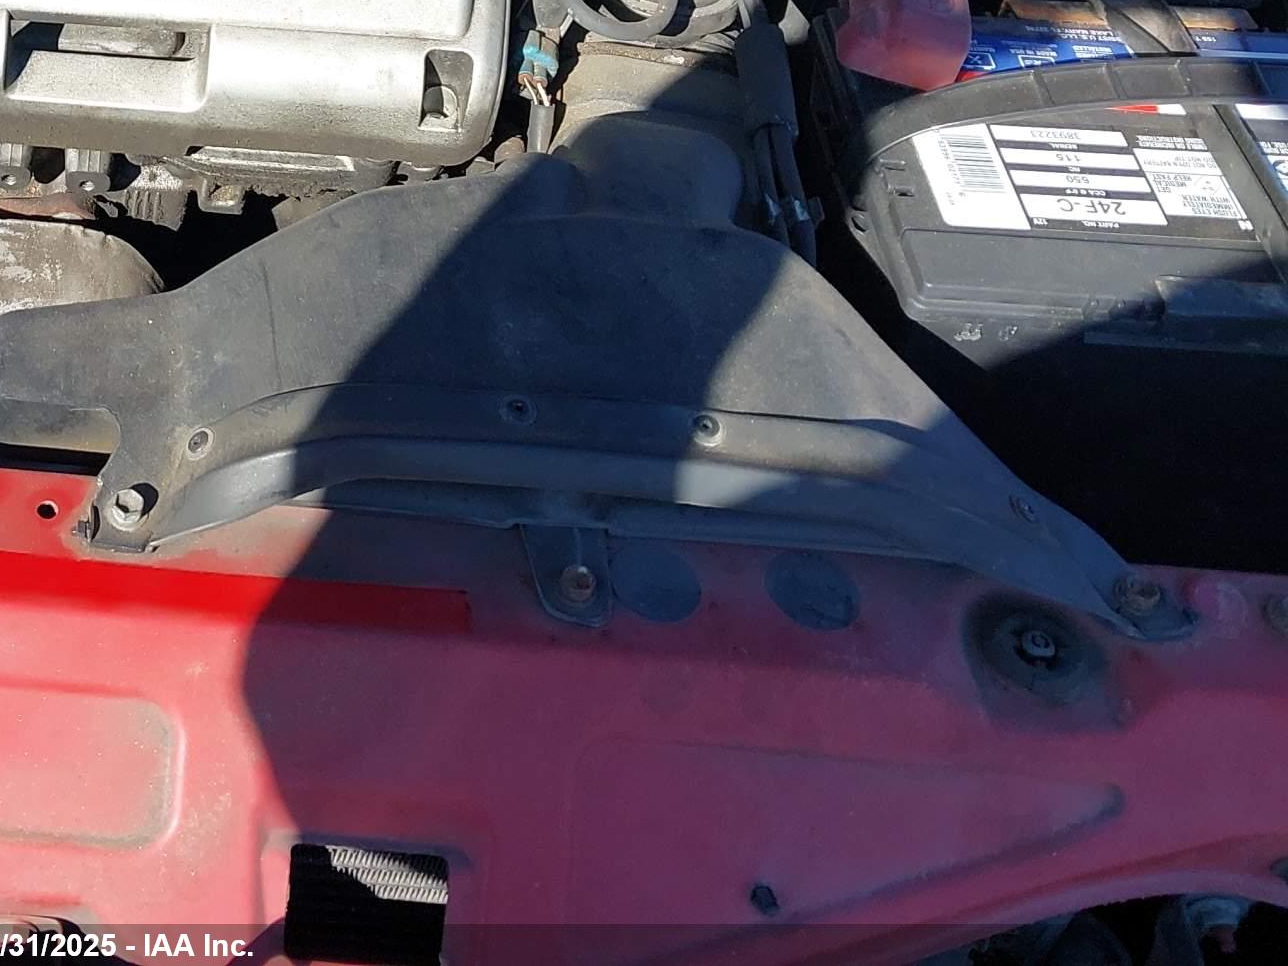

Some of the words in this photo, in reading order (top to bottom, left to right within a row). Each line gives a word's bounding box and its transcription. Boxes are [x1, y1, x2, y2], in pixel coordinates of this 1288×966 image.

[1056, 153, 1081, 163] 115
[1066, 175, 1090, 185] 650
[1056, 198, 1127, 216] 24F-C
